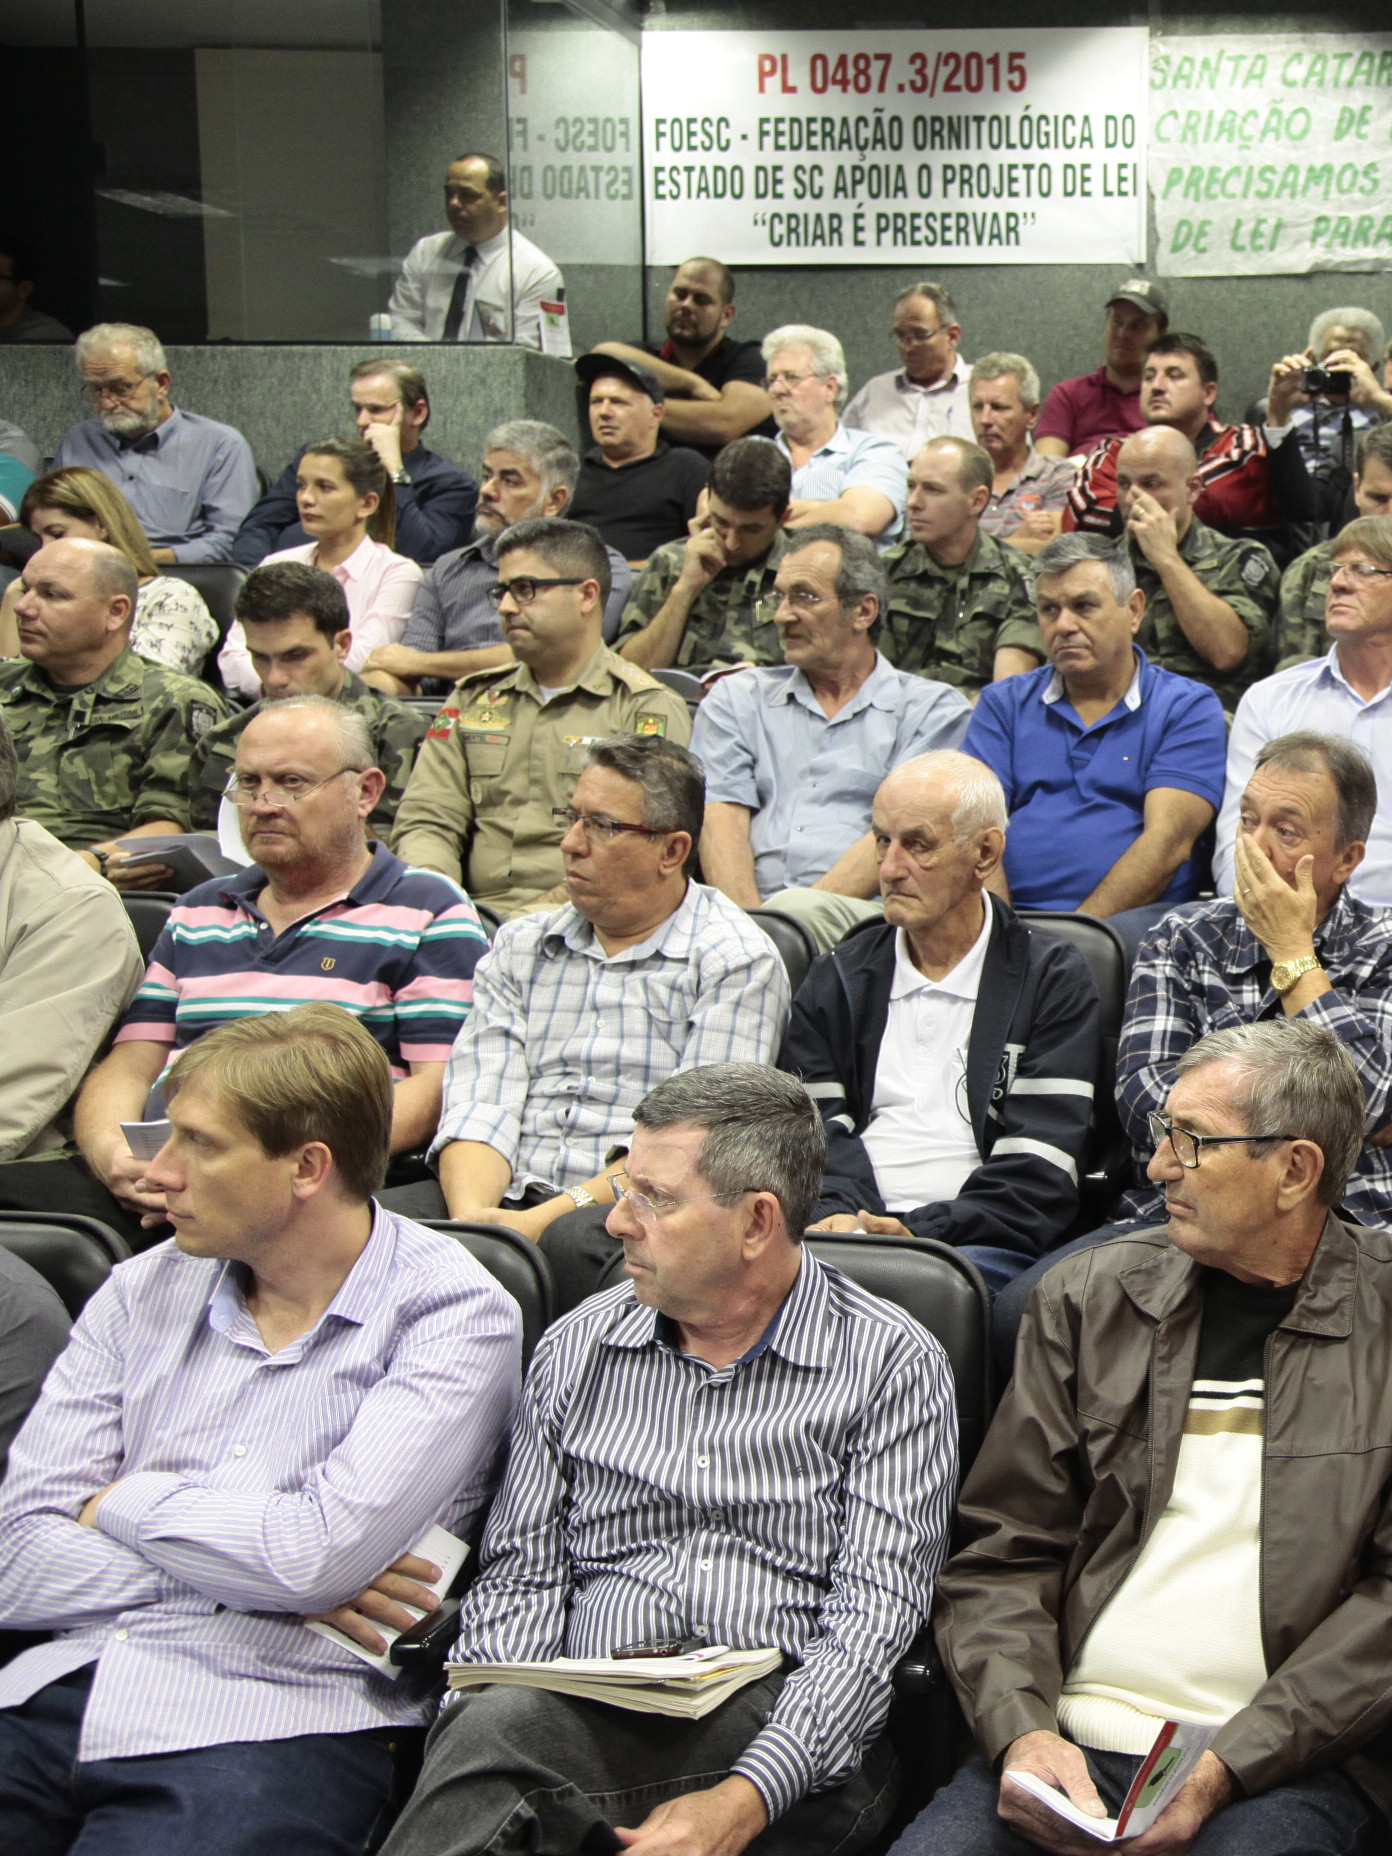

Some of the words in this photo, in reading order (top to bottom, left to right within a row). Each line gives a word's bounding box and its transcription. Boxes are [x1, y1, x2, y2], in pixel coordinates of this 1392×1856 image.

[757, 53, 797, 94] PL
[810, 51, 1026, 97] 0487.3/2015
[1150, 49, 1269, 90] SANTA
[656, 115, 731, 153] FOESC
[759, 108, 903, 161] FEDERAÇÃO
[914, 106, 1092, 151] ORNITOLÓGICA
[1104, 114, 1136, 150] DO
[1154, 98, 1312, 150] CRIAÇÃO
[1334, 105, 1370, 141] DE
[655, 165, 744, 200] ESTADO
[755, 165, 785, 199] DE
[795, 164, 824, 199] SC
[833, 164, 908, 199] APOIA
[917, 164, 932, 198] O
[942, 163, 1054, 199] PROJETO
[1063, 163, 1092, 197] DE
[1104, 163, 1138, 197] LEI
[1162, 161, 1379, 202] PRECISAMOS
[853, 204, 866, 246] É
[1171, 219, 1213, 253] DE
[1230, 217, 1283, 252] LEI
